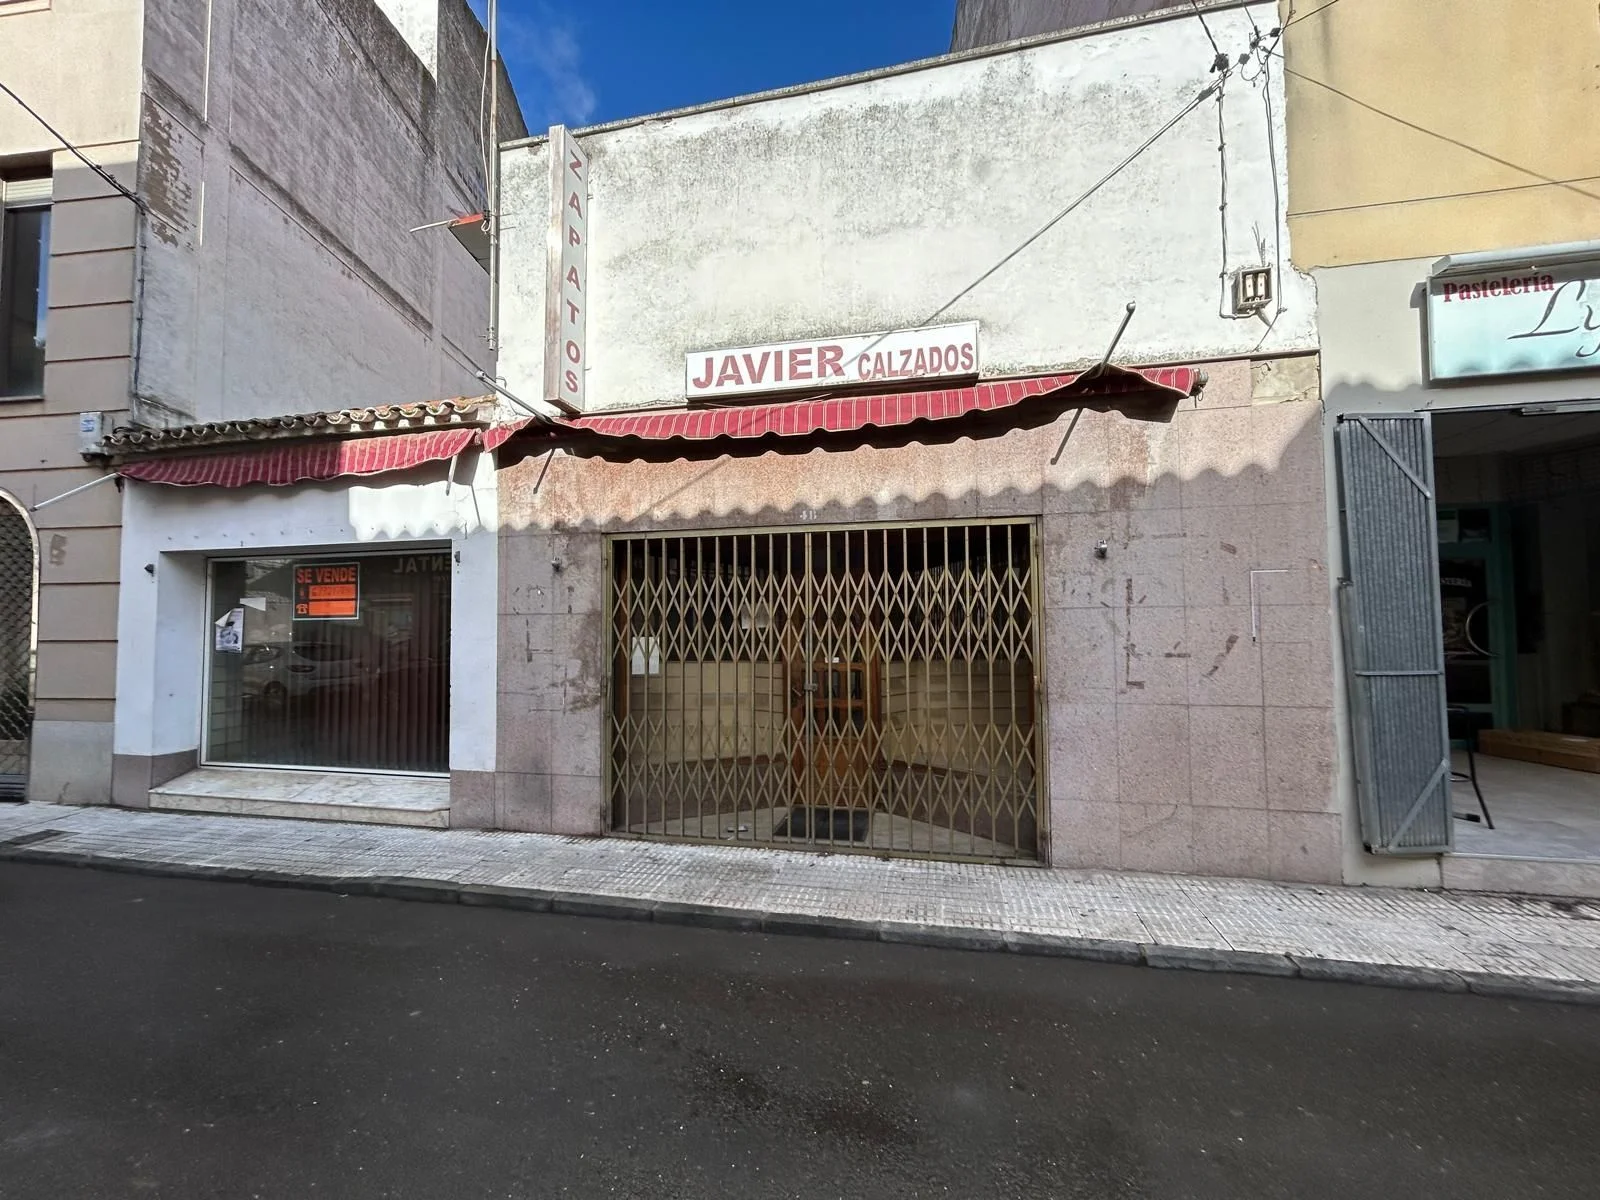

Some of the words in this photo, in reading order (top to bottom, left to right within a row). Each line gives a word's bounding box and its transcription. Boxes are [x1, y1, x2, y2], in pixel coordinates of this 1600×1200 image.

[565, 152, 583, 393] ZAPATOS
[1443, 271, 1555, 303] Pastelería
[692, 344, 845, 389] JAVIER
[857, 342, 974, 381] CALZADOS
[296, 568, 312, 584] SE
[316, 567, 356, 583] VENDE
